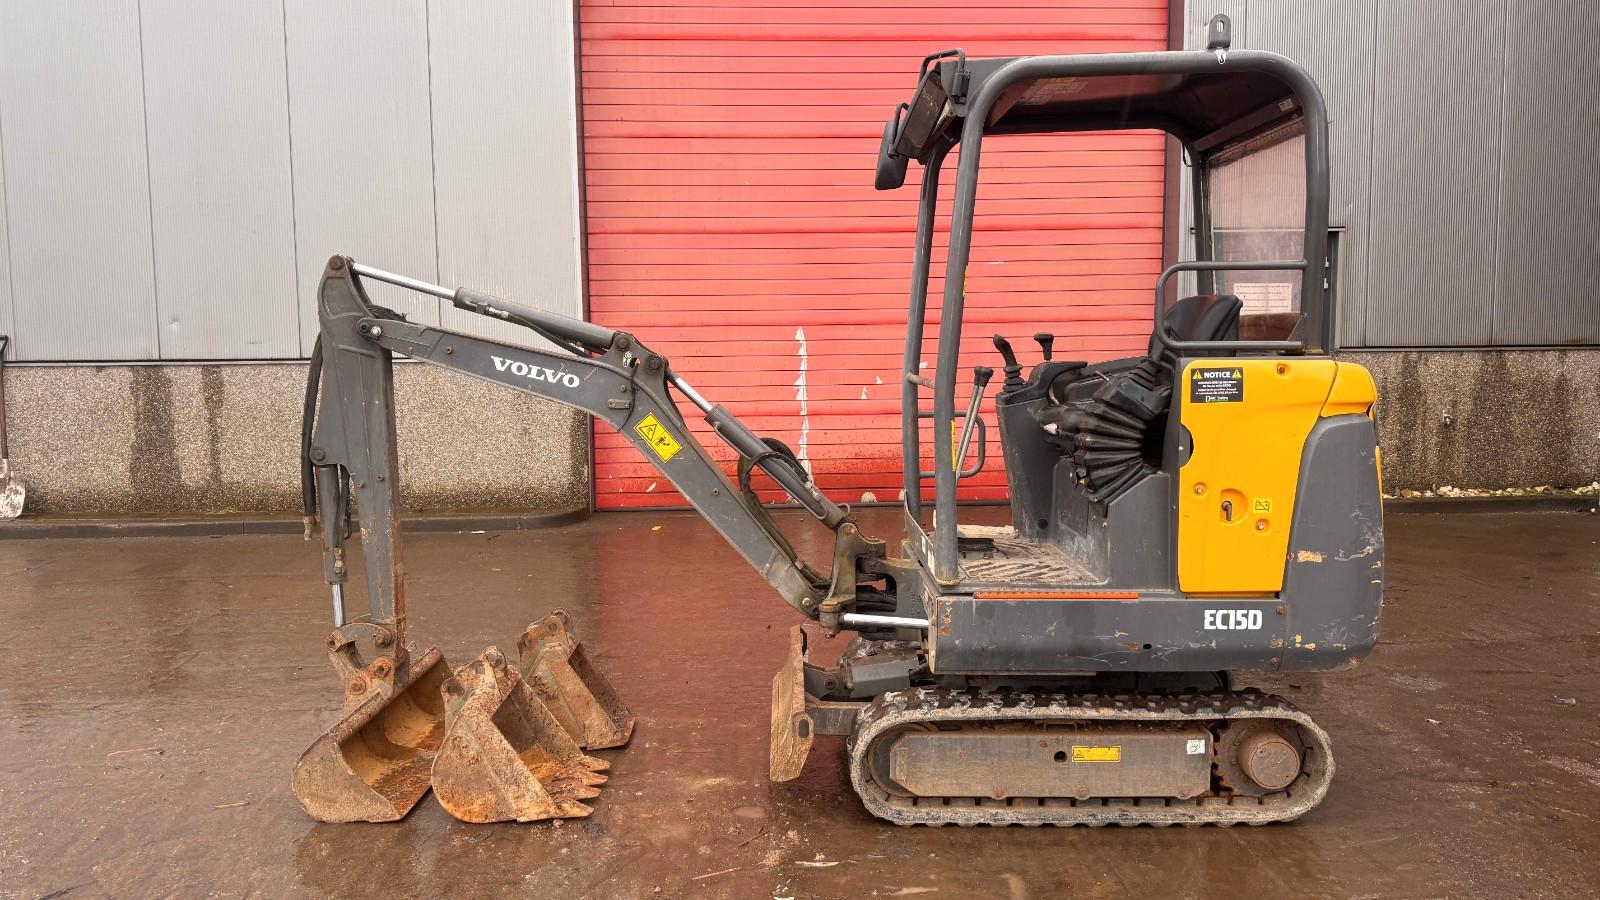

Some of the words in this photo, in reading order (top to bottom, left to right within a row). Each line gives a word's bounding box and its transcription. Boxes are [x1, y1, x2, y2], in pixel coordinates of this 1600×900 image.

[490, 355, 580, 388] VOLVO
[1203, 371, 1231, 379] NOTICE
[1204, 609, 1262, 630] EC15D
